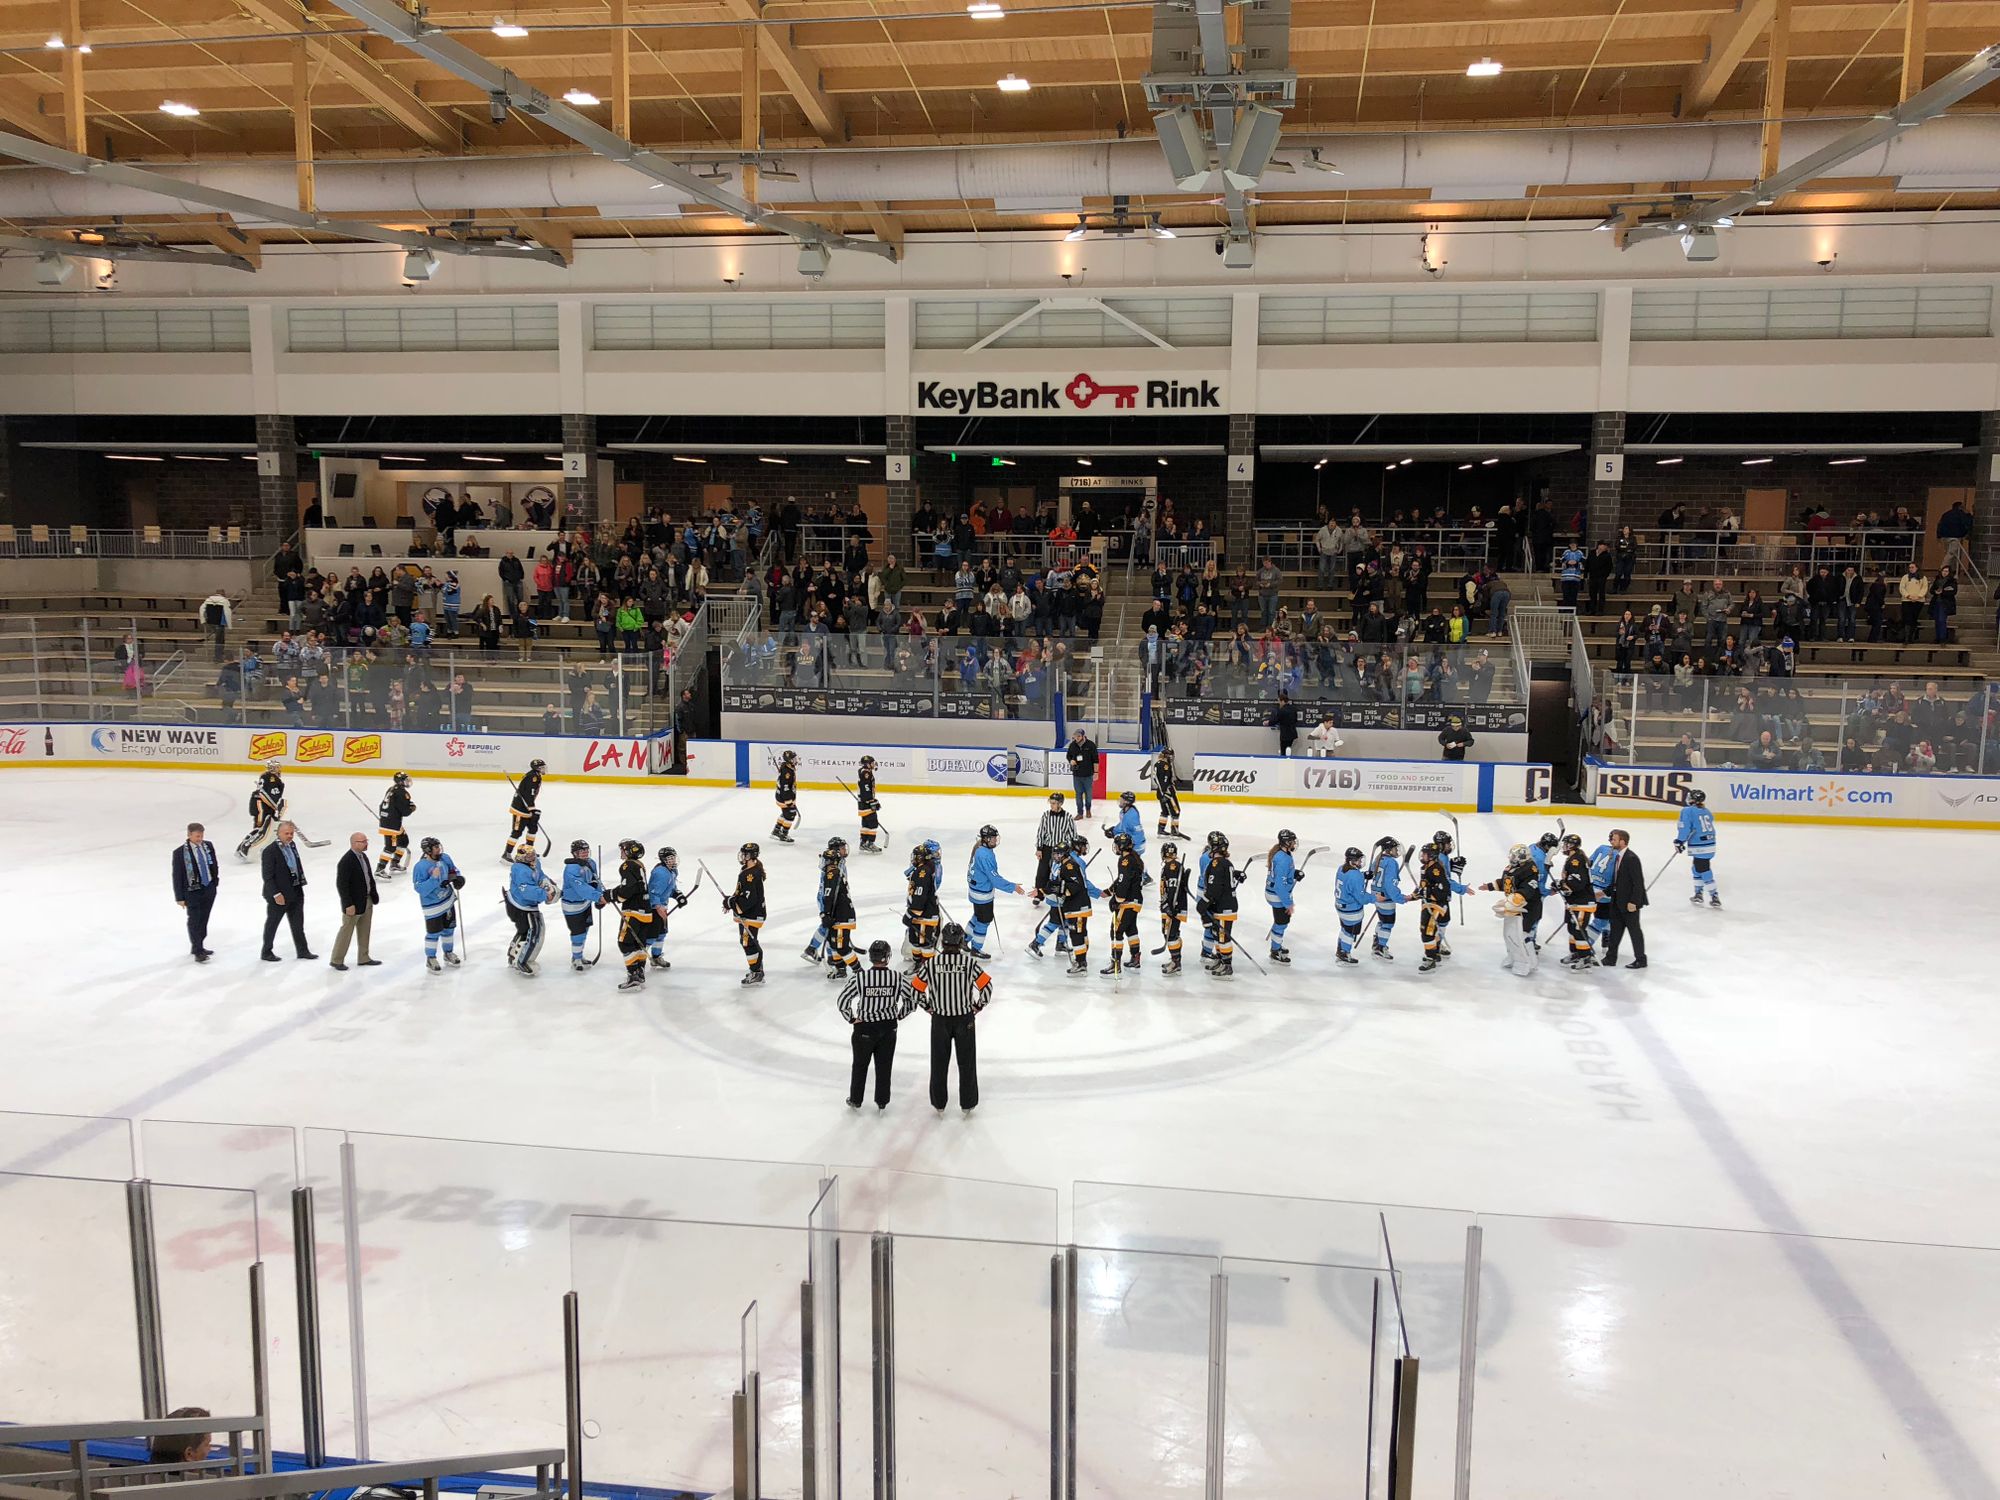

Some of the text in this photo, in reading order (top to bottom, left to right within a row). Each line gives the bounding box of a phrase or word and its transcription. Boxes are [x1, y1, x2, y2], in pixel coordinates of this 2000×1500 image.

[918, 380, 1220, 415] KeyBank Rink
[571, 460, 578, 471] 2
[894, 462, 902, 473] 3
[1237, 462, 1245, 473] 4
[1605, 461, 1613, 473] 5
[1070, 477, 1091, 487] (716)
[121, 729, 217, 745] NEW WAVE
[159, 744, 219, 756] Corporation
[583, 741, 623, 772] LA
[927, 758, 985, 773] BUFFALO
[1303, 766, 1361, 791] (716)
[1367, 784, 1454, 793] 716FOODANDSPORT.COM
[1730, 782, 1893, 804] Walmart com
[1699, 815, 1713, 833] 16
[1590, 852, 1609, 874] 14
[935, 963, 966, 974] WALLACE
[865, 986, 894, 997] BRZYSKI
